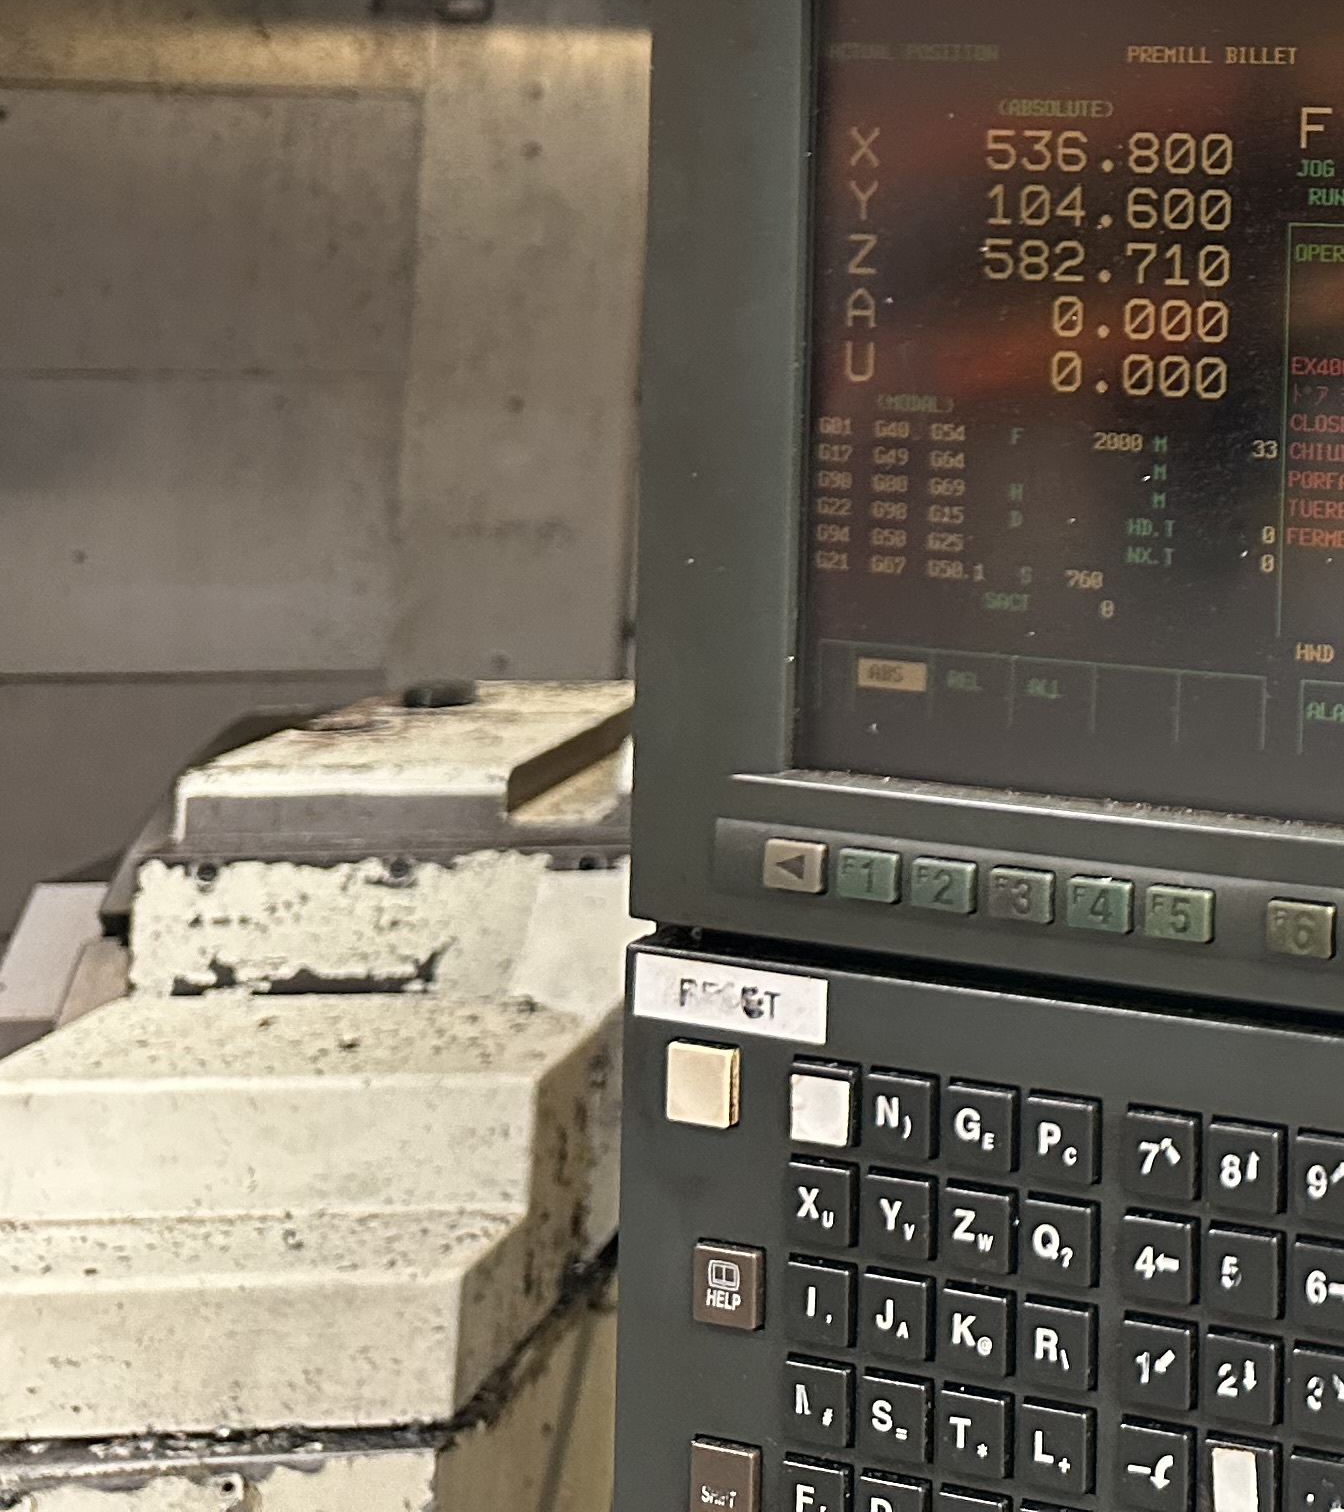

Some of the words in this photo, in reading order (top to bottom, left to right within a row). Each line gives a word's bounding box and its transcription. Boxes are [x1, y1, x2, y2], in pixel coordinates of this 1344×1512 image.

[1127, 46, 1212, 64] PREMILL
[1225, 46, 1297, 65] BILLET
[850, 127, 880, 168] X
[985, 130, 1233, 175] 536.800
[850, 180, 878, 221] Y
[986, 184, 1232, 231] 104.600
[848, 234, 877, 275] Z
[981, 239, 1230, 287] 582.710
[706, 1289, 741, 1312] HELP
